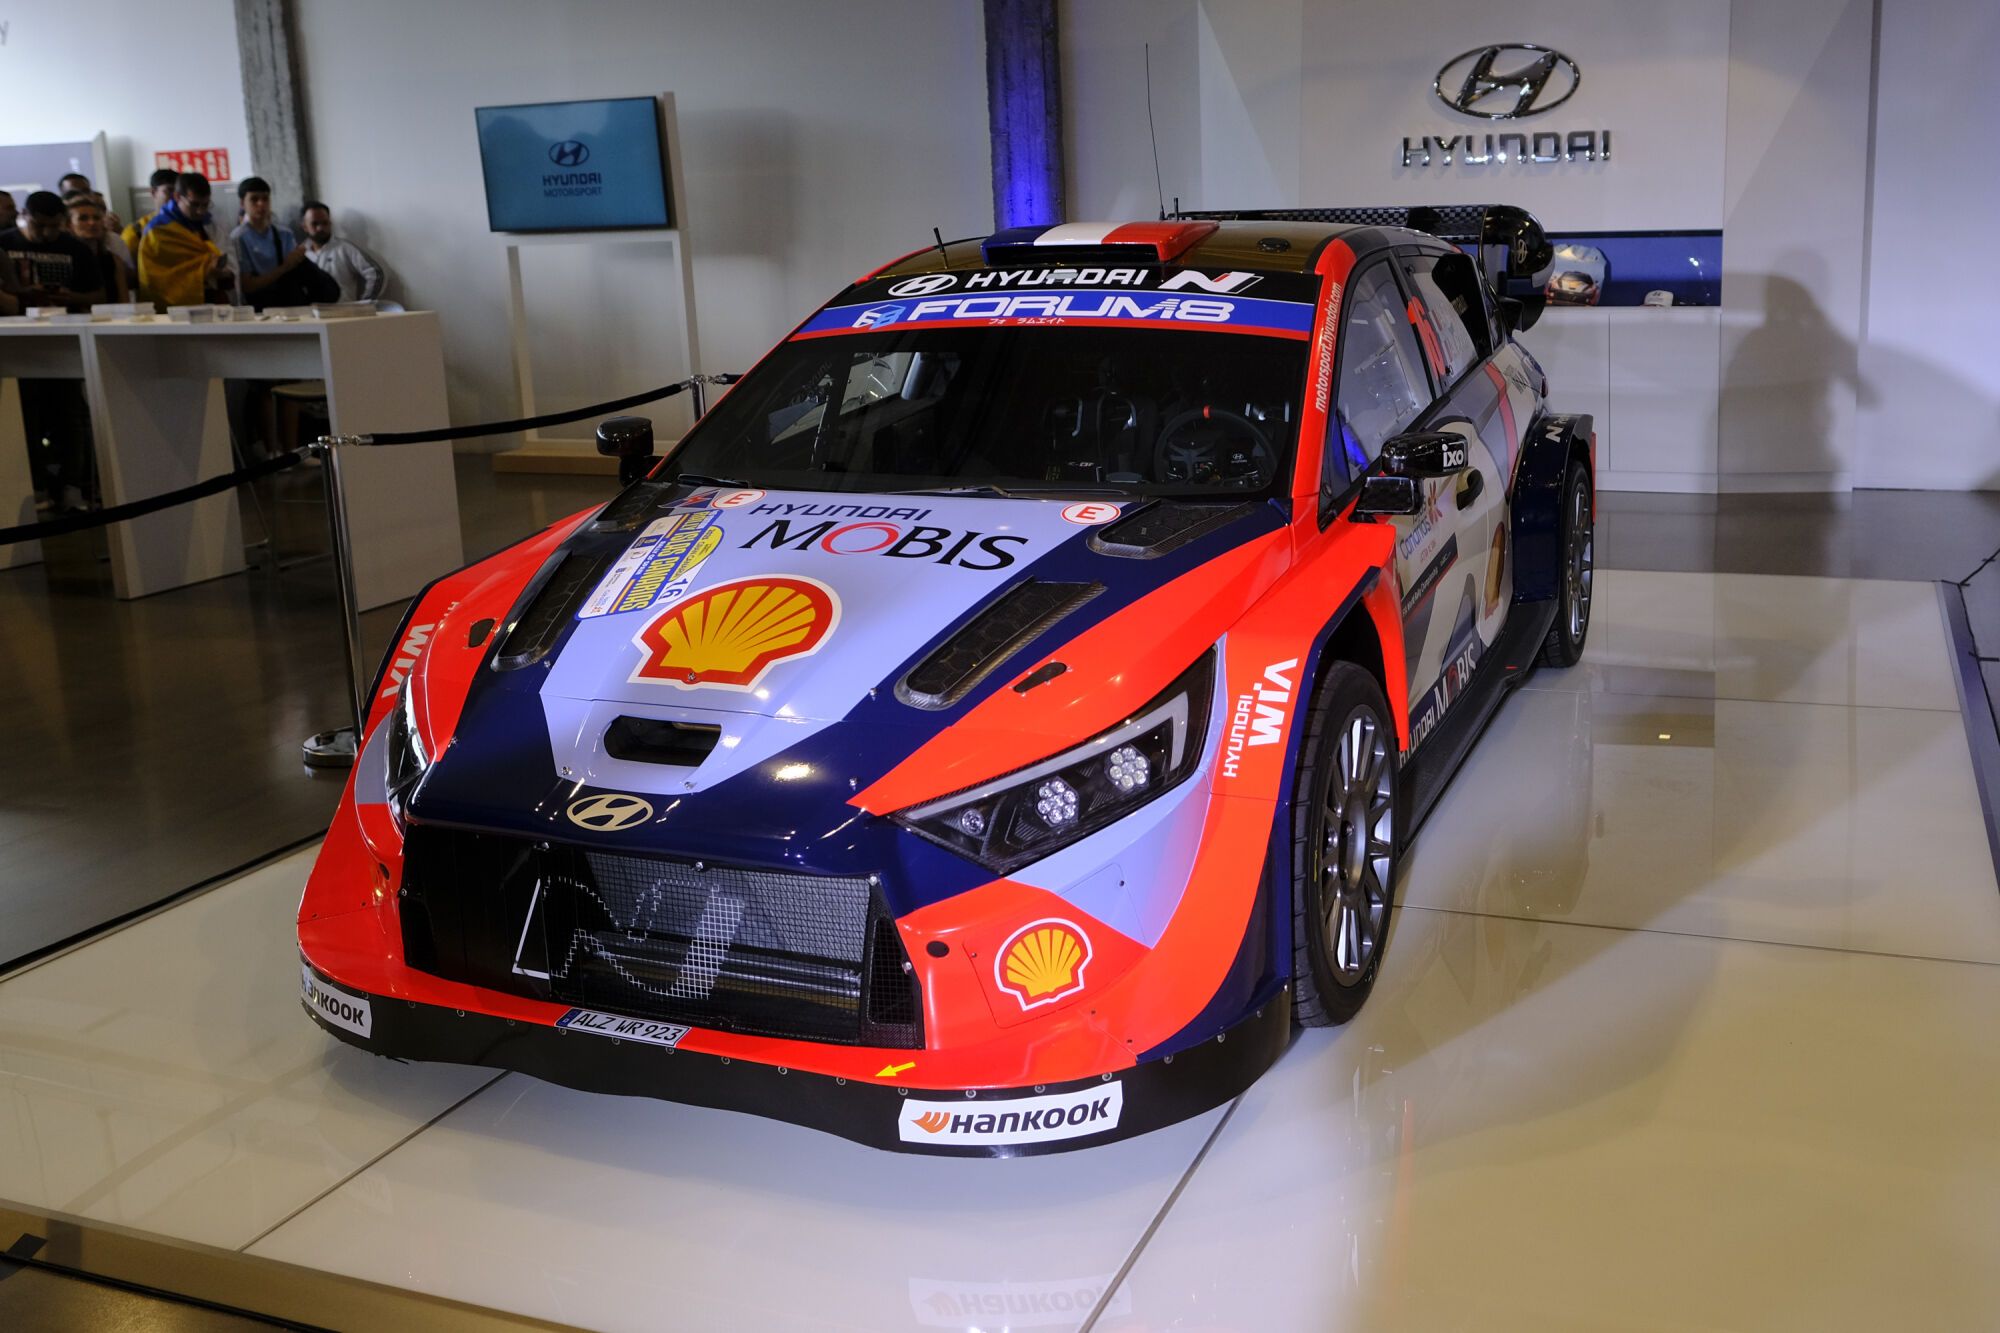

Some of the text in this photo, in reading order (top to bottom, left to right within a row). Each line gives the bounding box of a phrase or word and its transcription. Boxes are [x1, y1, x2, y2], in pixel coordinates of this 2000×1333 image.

[1402, 130, 1610, 167] HYUNDAI
[542, 171, 602, 187] HYUNDAI
[543, 186, 602, 198] MOTORSPORT
[965, 268, 1148, 289] HYUNDAI
[907, 296, 1235, 323] FORUM8
[1315, 281, 1342, 413] motorsport.hyundai.com
[1442, 443, 1464, 467] ixo
[723, 493, 753, 505] E
[748, 503, 932, 522] HYUNDAI
[1075, 506, 1105, 520] E
[657, 531, 700, 558] ISLAS
[738, 519, 1028, 571] MOBIS
[619, 556, 681, 613] CANARIAS
[1223, 694, 1254, 778] HYUNDAI
[573, 1013, 617, 1030] ALZ
[614, 1019, 643, 1035] WR
[641, 1026, 683, 1041] 923
